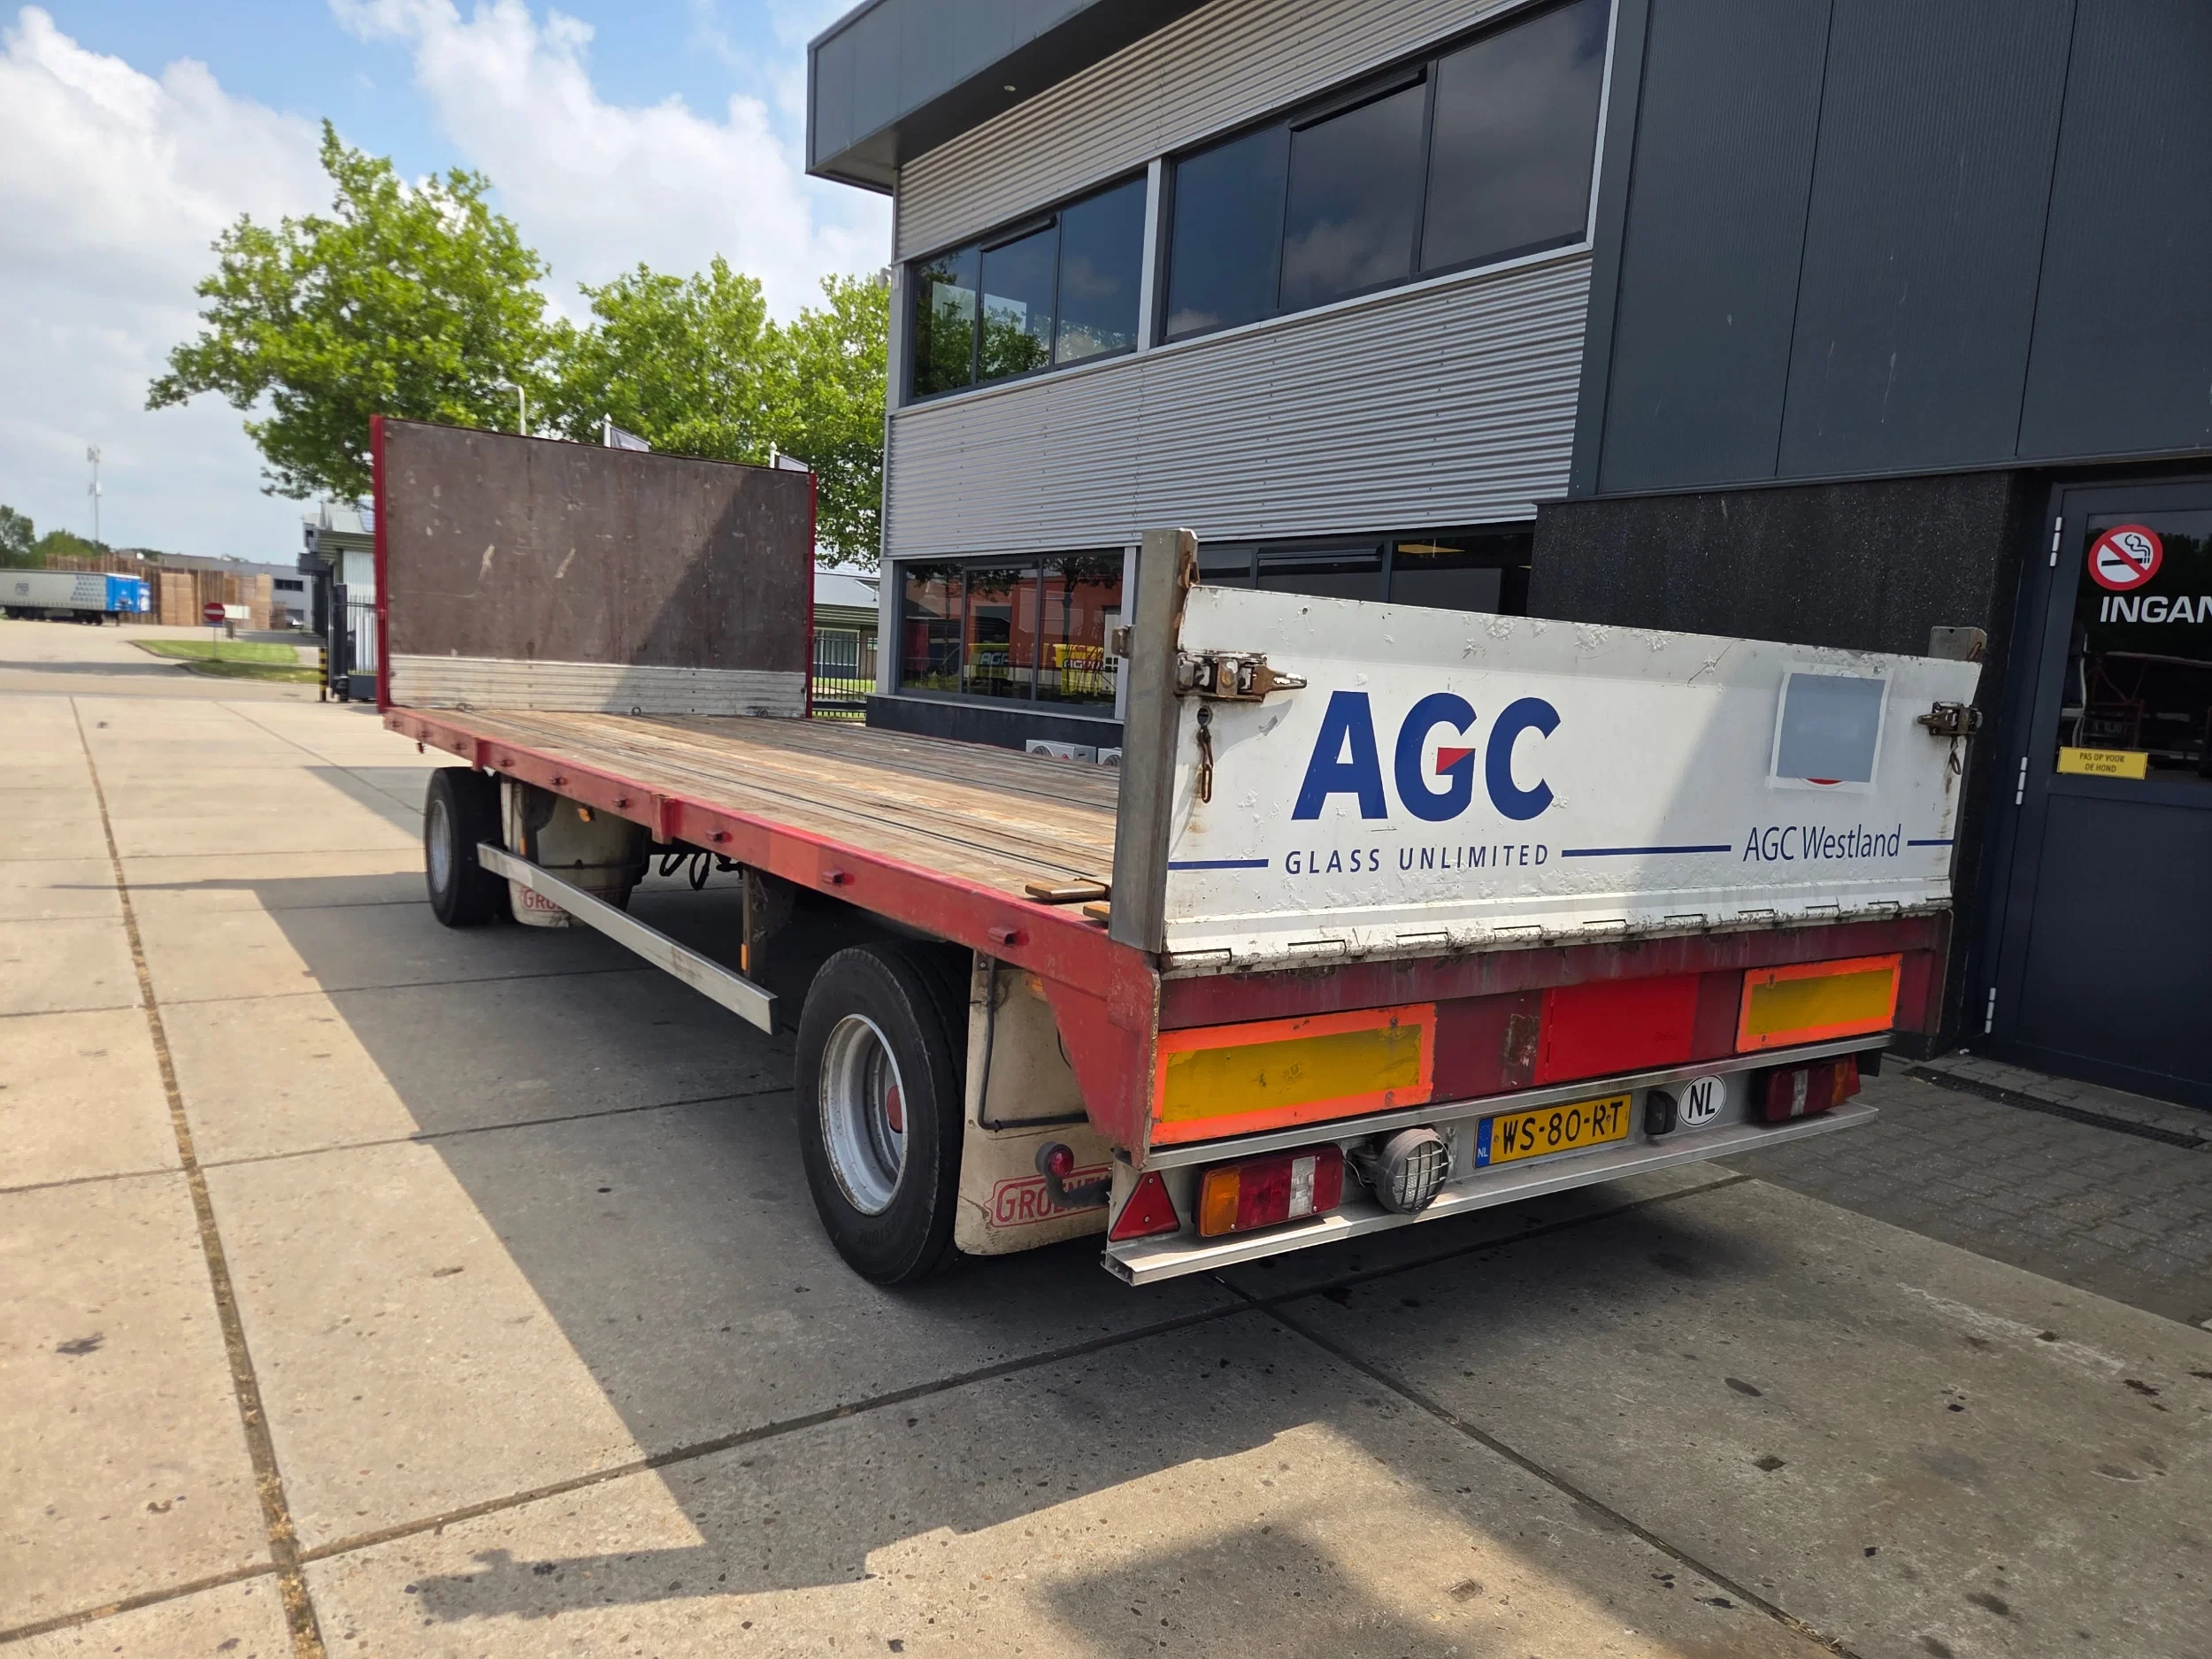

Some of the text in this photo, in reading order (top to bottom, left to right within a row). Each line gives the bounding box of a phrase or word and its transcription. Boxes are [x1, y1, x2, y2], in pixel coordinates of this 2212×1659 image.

[1291, 690, 1561, 822] AGC
[2079, 752, 2125, 763] PAS OP VOOR
[2085, 763, 2117, 772] DE HOND
[1285, 844, 1548, 874] GLASS UNLIMITED
[1743, 824, 1901, 862] AGC Westland
[1688, 1081, 1715, 1118] NL
[1503, 1100, 1624, 1155] WS-80-RT
[1477, 1147, 1489, 1158] NL
